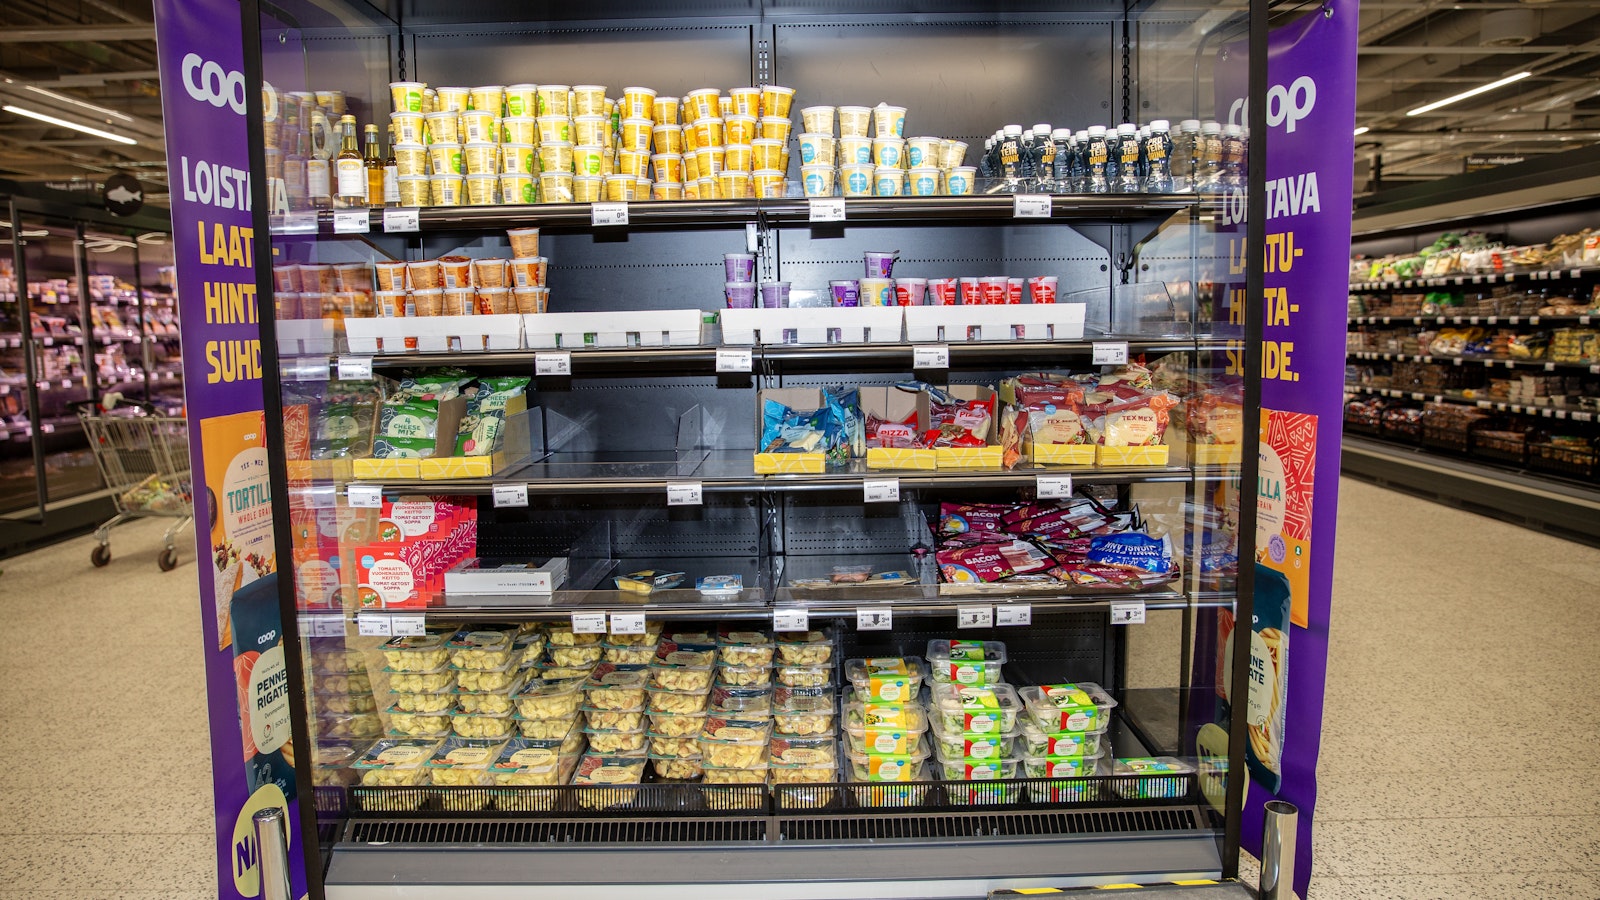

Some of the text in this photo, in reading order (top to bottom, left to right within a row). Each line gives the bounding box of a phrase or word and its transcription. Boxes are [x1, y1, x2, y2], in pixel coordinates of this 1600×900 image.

[393, 423, 421, 431] CHEESE
[397, 429, 416, 437] MIX
[880, 429, 909, 437] PIZZA
[227, 480, 273, 513] TORTILL
[238, 511, 257, 525] WHOLE
[964, 553, 1001, 565] BACON
[258, 629, 276, 645] coop
